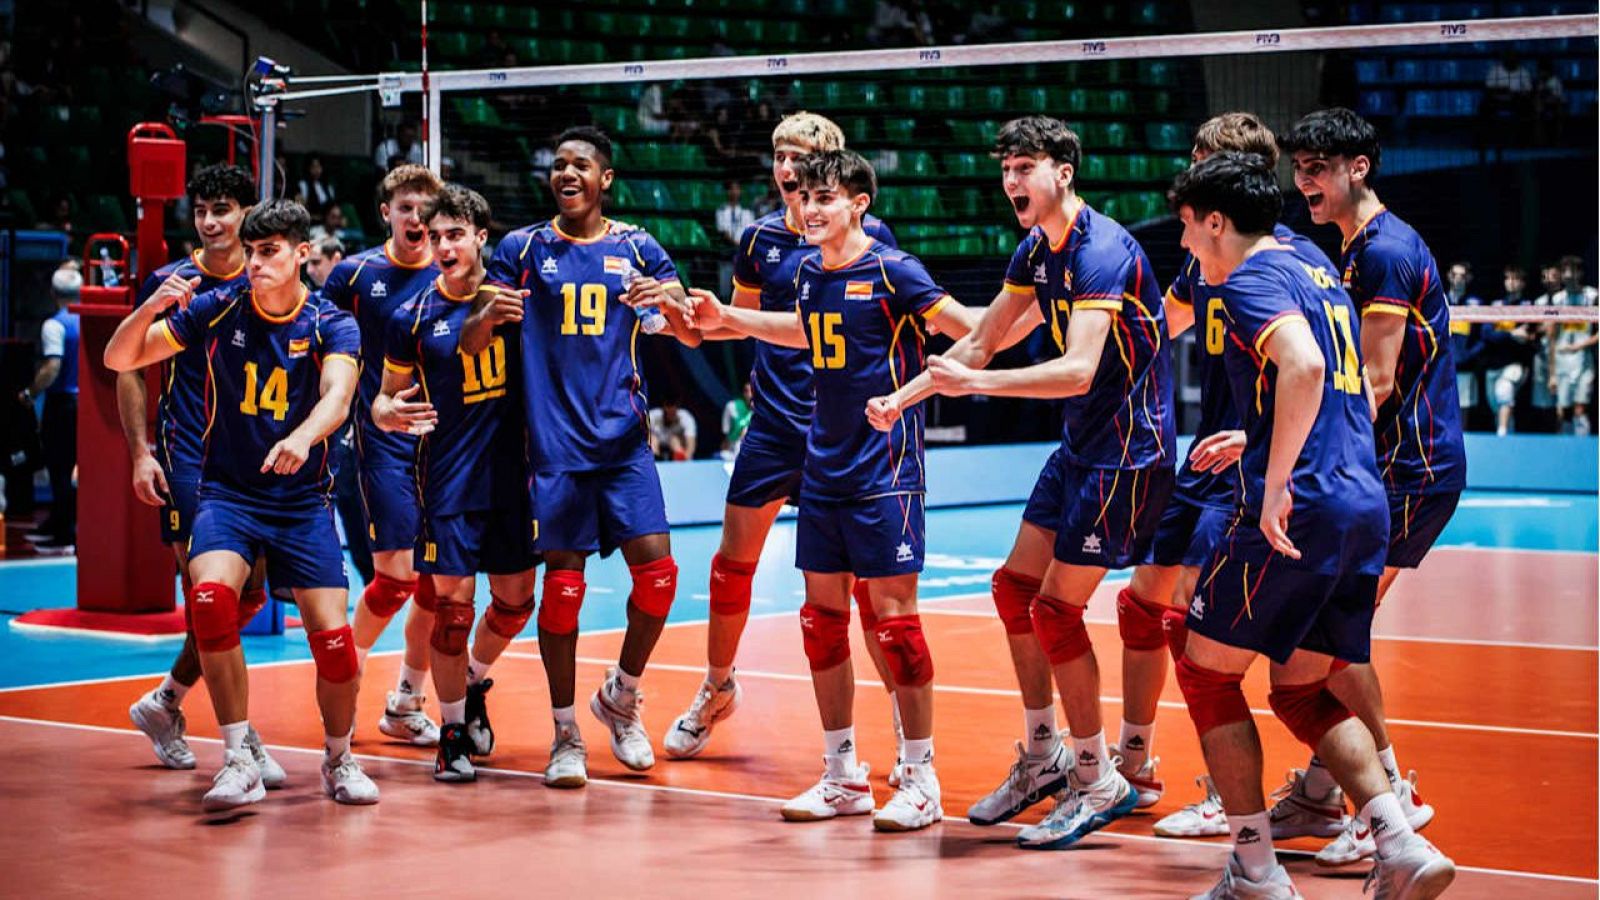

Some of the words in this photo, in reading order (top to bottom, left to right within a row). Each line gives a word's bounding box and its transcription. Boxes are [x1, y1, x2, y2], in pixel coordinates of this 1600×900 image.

[1256, 33, 1280, 44] FIVB
[1440, 24, 1466, 35] FIVB
[560, 282, 608, 336] 19
[1206, 297, 1225, 355] 6
[456, 335, 506, 393] 10
[808, 311, 846, 369] 15
[239, 360, 290, 421] 14
[170, 510, 180, 531] 9
[424, 541, 437, 563] 10
